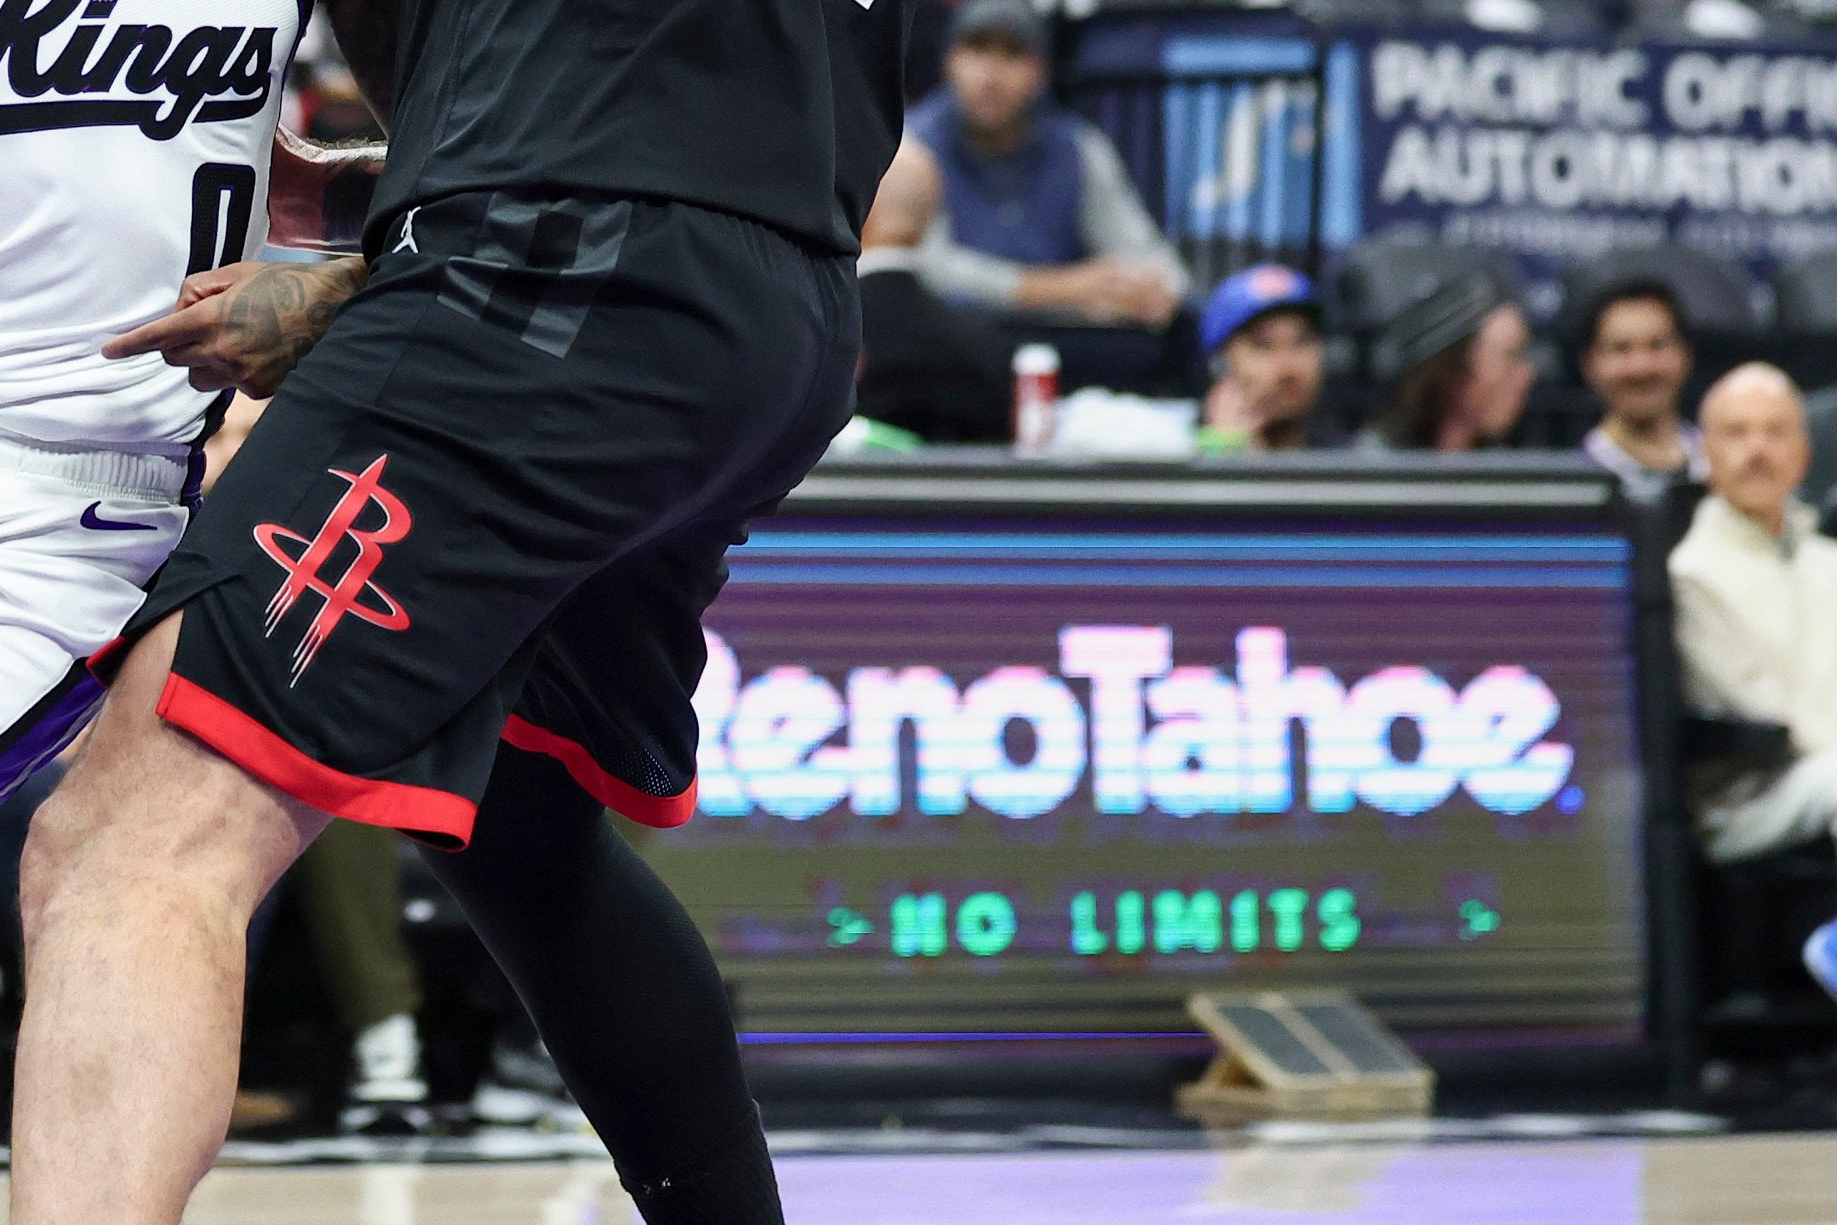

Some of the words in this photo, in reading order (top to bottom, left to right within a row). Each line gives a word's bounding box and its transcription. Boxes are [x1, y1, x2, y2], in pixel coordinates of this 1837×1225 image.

[1373, 40, 1649, 128] PACIFIC
[1663, 51, 1837, 130] OFFI
[185, 162, 256, 278] 0
[1071, 887, 1361, 955] LIMITS
